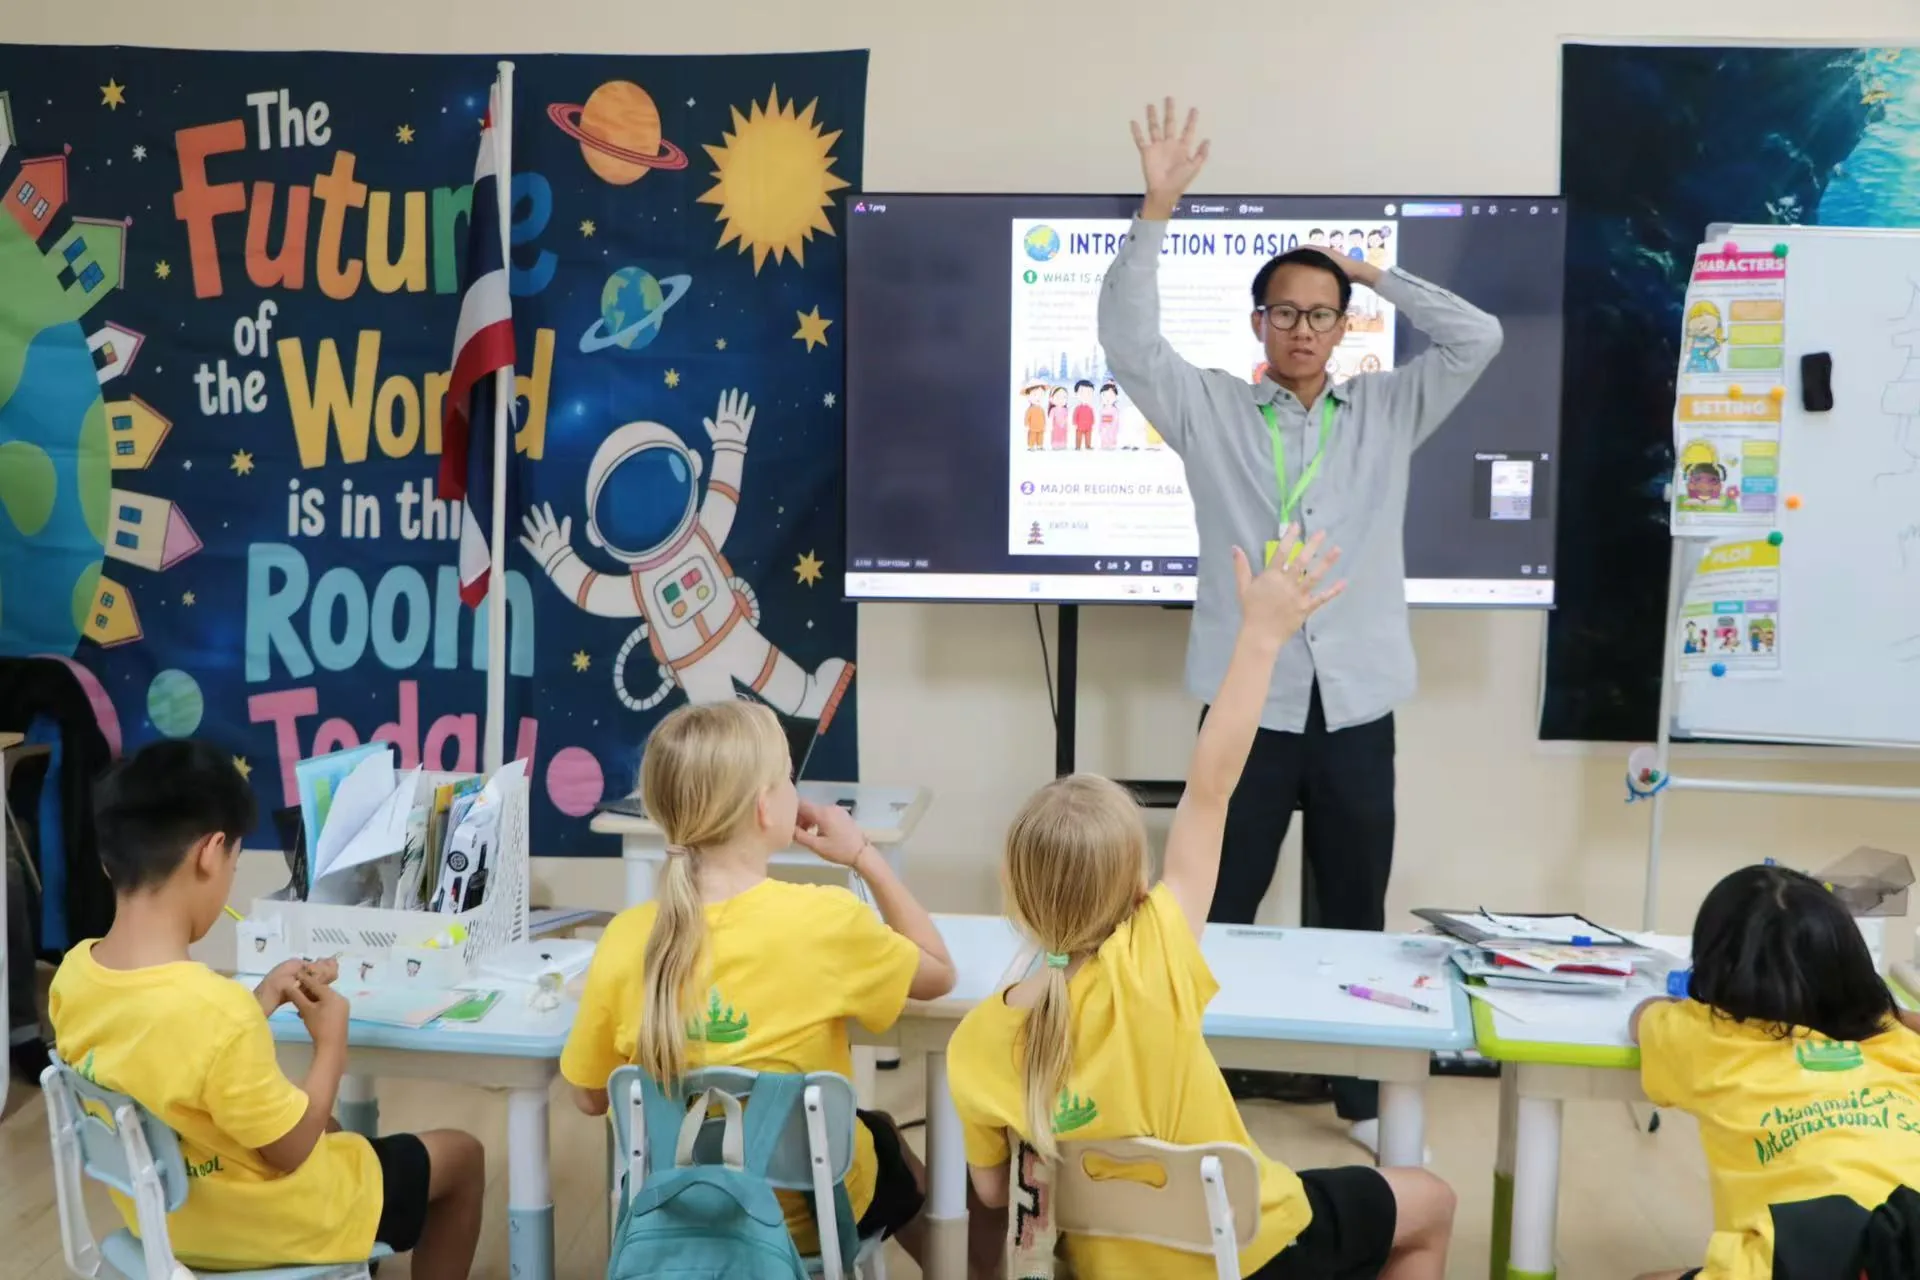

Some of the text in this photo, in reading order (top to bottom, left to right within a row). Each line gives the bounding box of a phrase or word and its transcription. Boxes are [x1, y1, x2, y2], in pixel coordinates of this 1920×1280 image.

[246, 88, 332, 150] The
[1070, 232, 1299, 257] INTRTION TO ASIA
[1043, 273, 1077, 283] WHAT
[1080, 273, 1091, 284] IS
[233, 299, 278, 358] of
[194, 327, 556, 470] the Word
[288, 477, 462, 541] is in thi
[1040, 484, 1080, 495] MAJOR
[1084, 484, 1134, 495] REGIONS
[1138, 484, 1153, 495] OF
[1156, 484, 1184, 495] ASIA
[245, 542, 535, 682] Room
